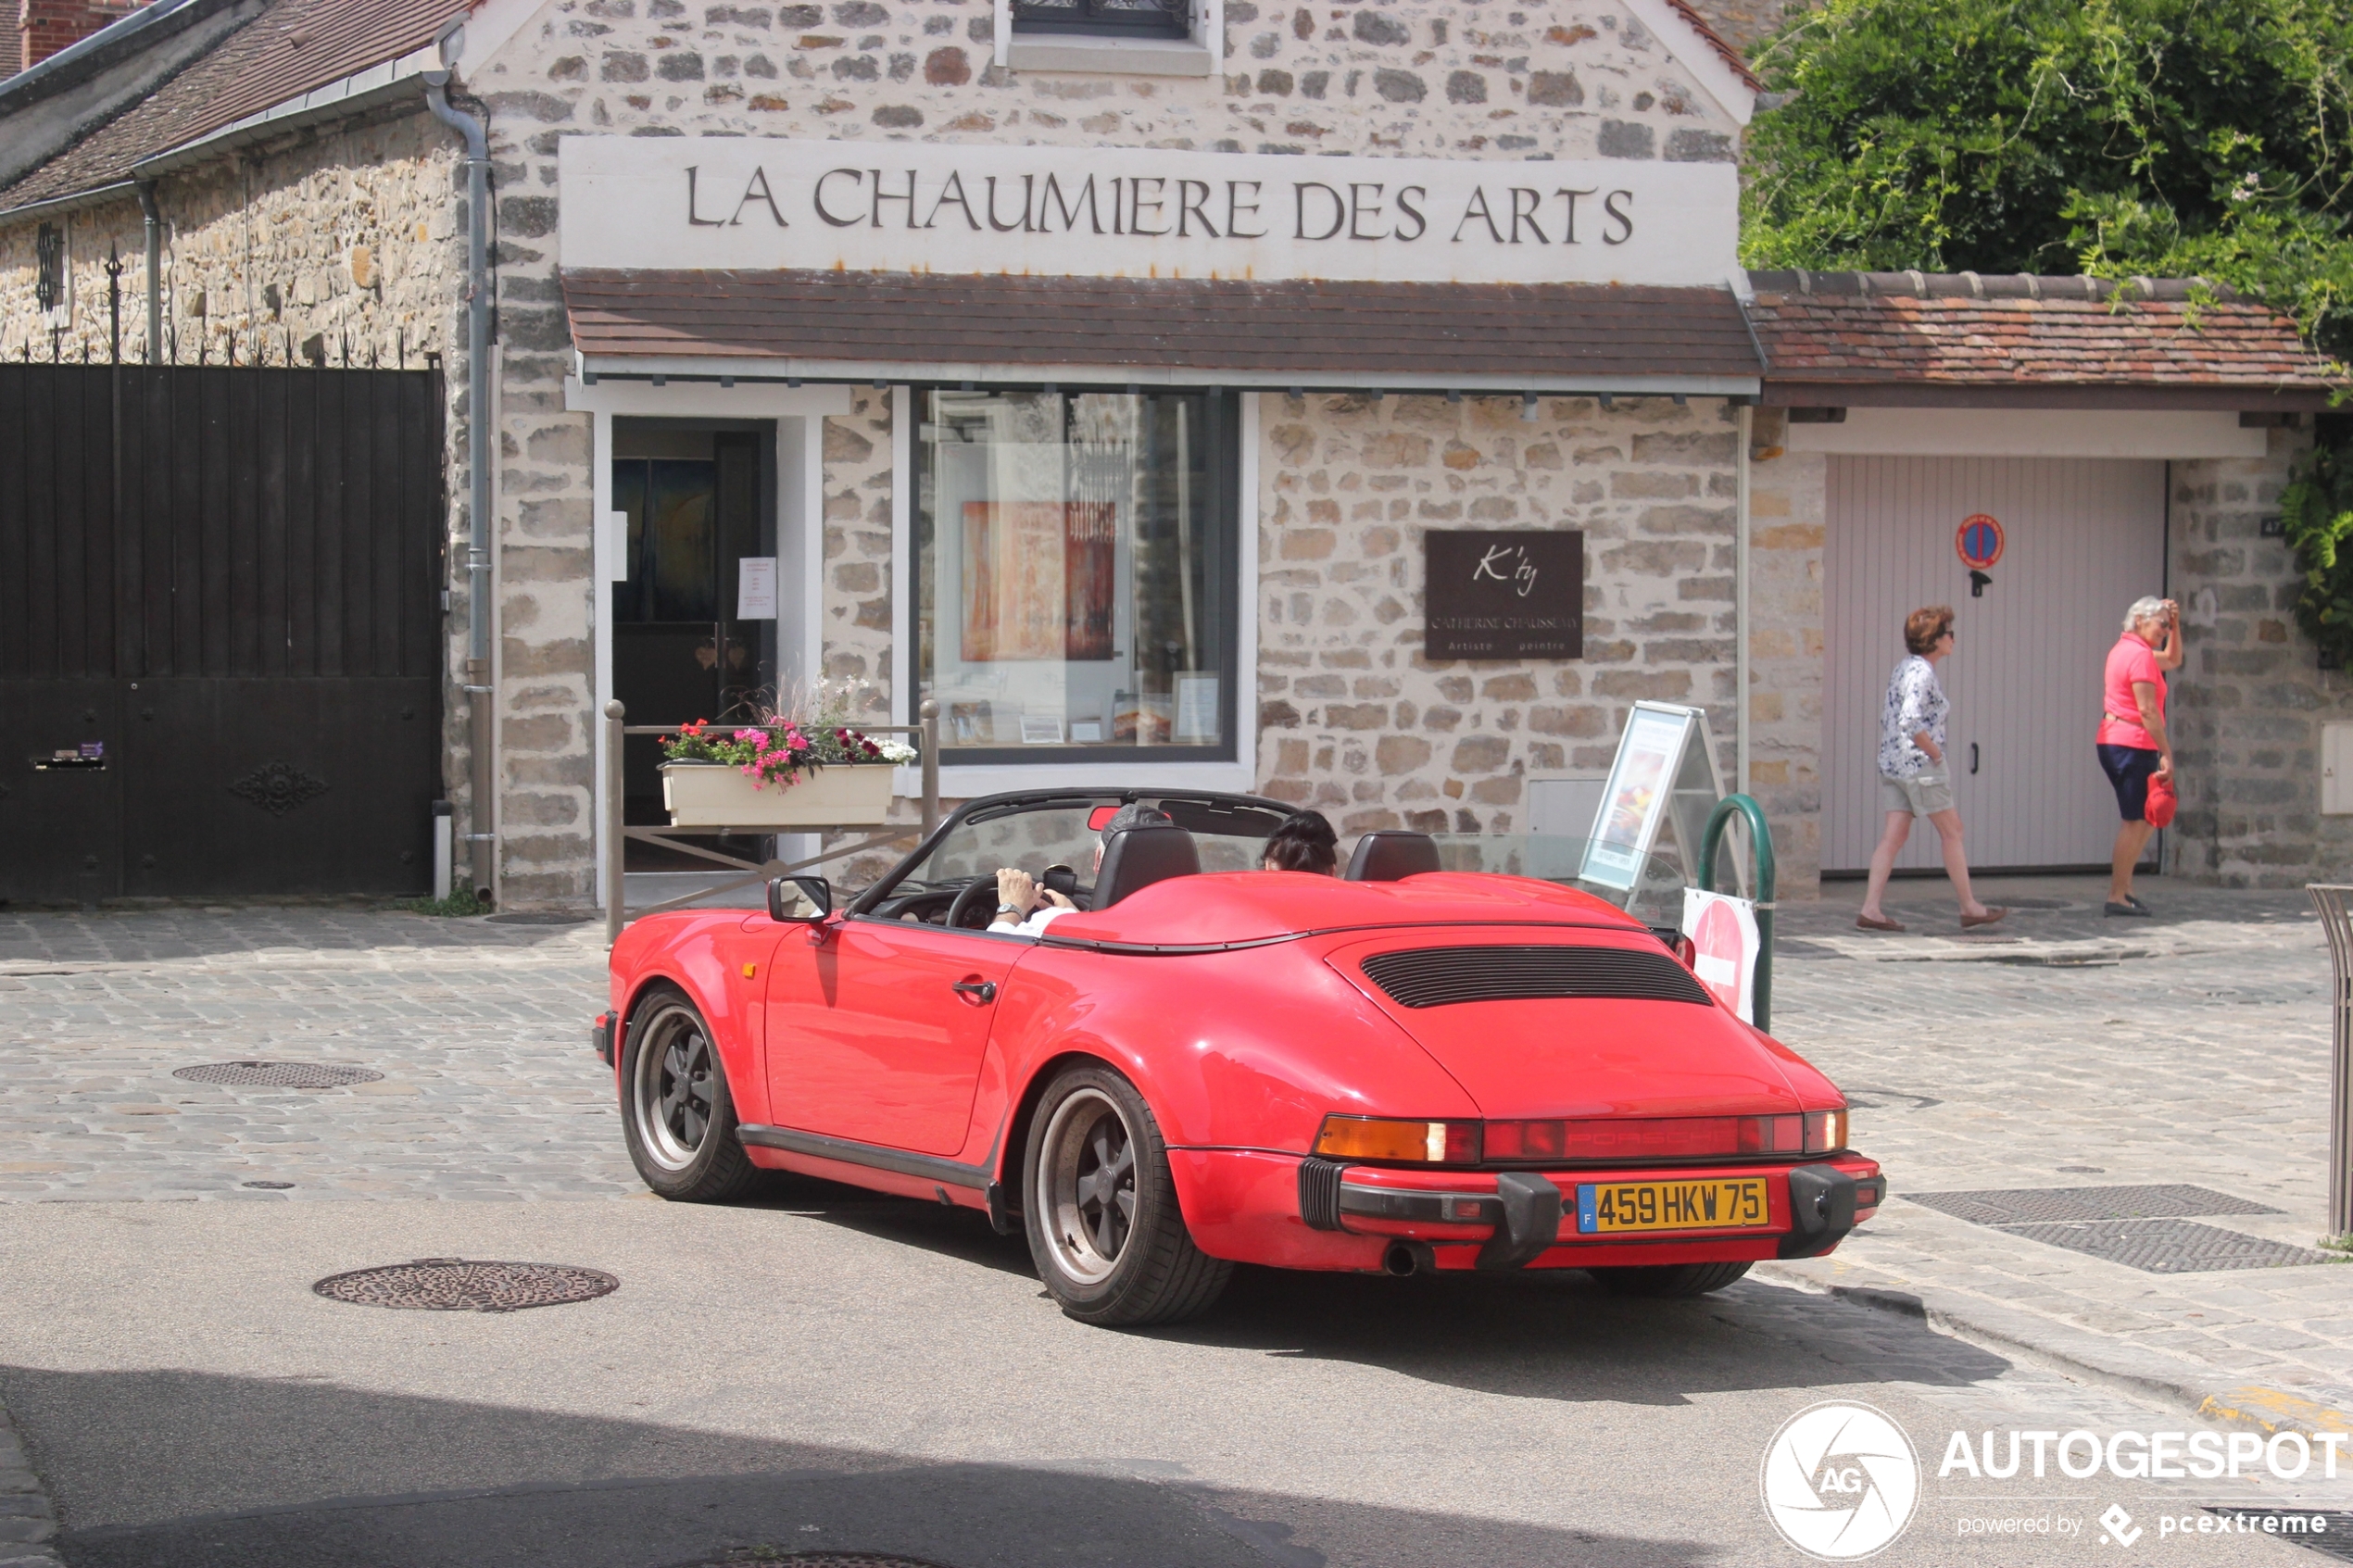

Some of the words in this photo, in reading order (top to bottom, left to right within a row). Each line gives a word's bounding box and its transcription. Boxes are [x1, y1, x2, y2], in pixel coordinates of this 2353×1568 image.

[684, 164, 789, 228] LA
[813, 168, 1268, 239] CHAUMIERE
[1292, 182, 1427, 242] DES
[1451, 184, 1634, 245] ARTS
[1431, 618, 1501, 629] CATHERINE
[1448, 642, 1492, 651] Artiste
[1519, 642, 1565, 652] peintre
[1567, 1131, 1736, 1146] PORSCHE
[1584, 1213, 1592, 1224] F
[1598, 1187, 1656, 1225] 459
[1663, 1185, 1717, 1223] HKW
[1724, 1183, 1759, 1220] 75
